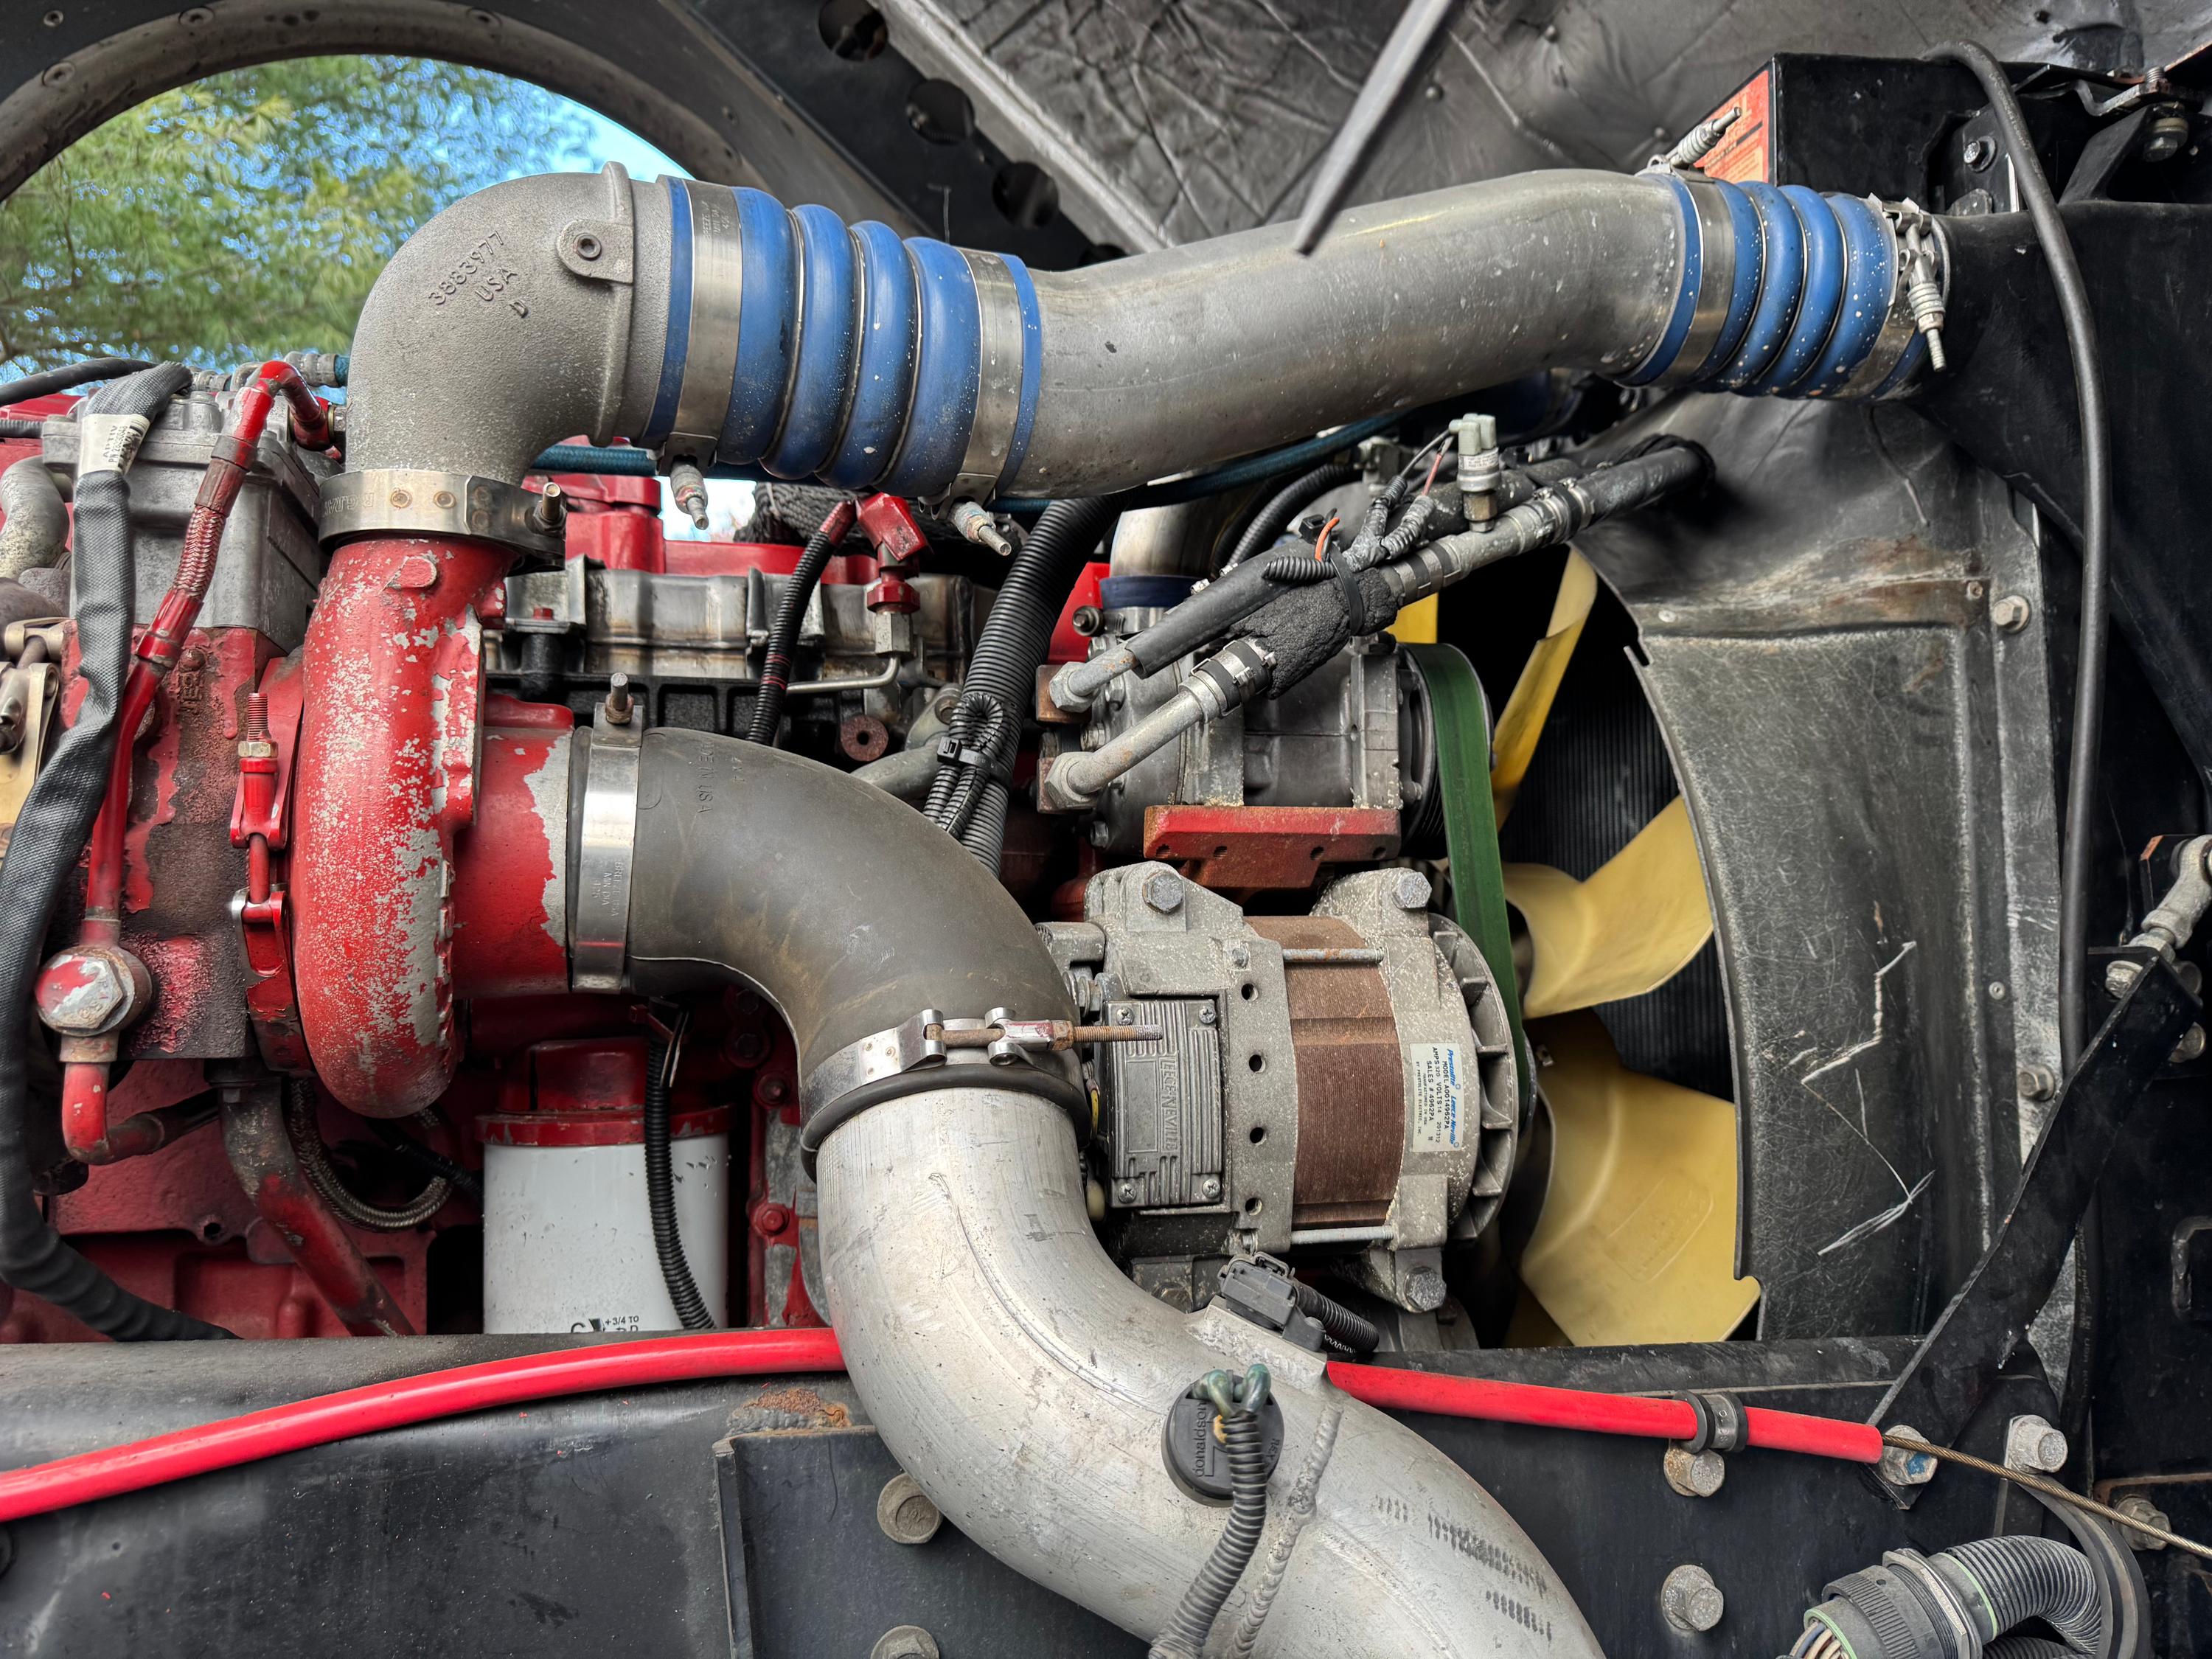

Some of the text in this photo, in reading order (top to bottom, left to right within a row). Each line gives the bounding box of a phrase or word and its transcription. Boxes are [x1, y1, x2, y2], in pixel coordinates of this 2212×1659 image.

[428, 230, 504, 306] 3883977
[474, 267, 518, 302] USA
[103, 425, 118, 458] APTIV
[698, 767, 714, 779] IN
[697, 784, 714, 813] USA
[601, 872, 613, 906] MIN DIA
[1426, 1060, 1434, 1083] SALES
[1432, 1046, 1440, 1065] AMPS
[1437, 1105, 1442, 1113] 14
[1447, 1048, 1457, 1144] Prestolite Leece-Neville
[605, 1315, 639, 1326] +3/4 TO
[1193, 1402, 1207, 1478] donaldson
